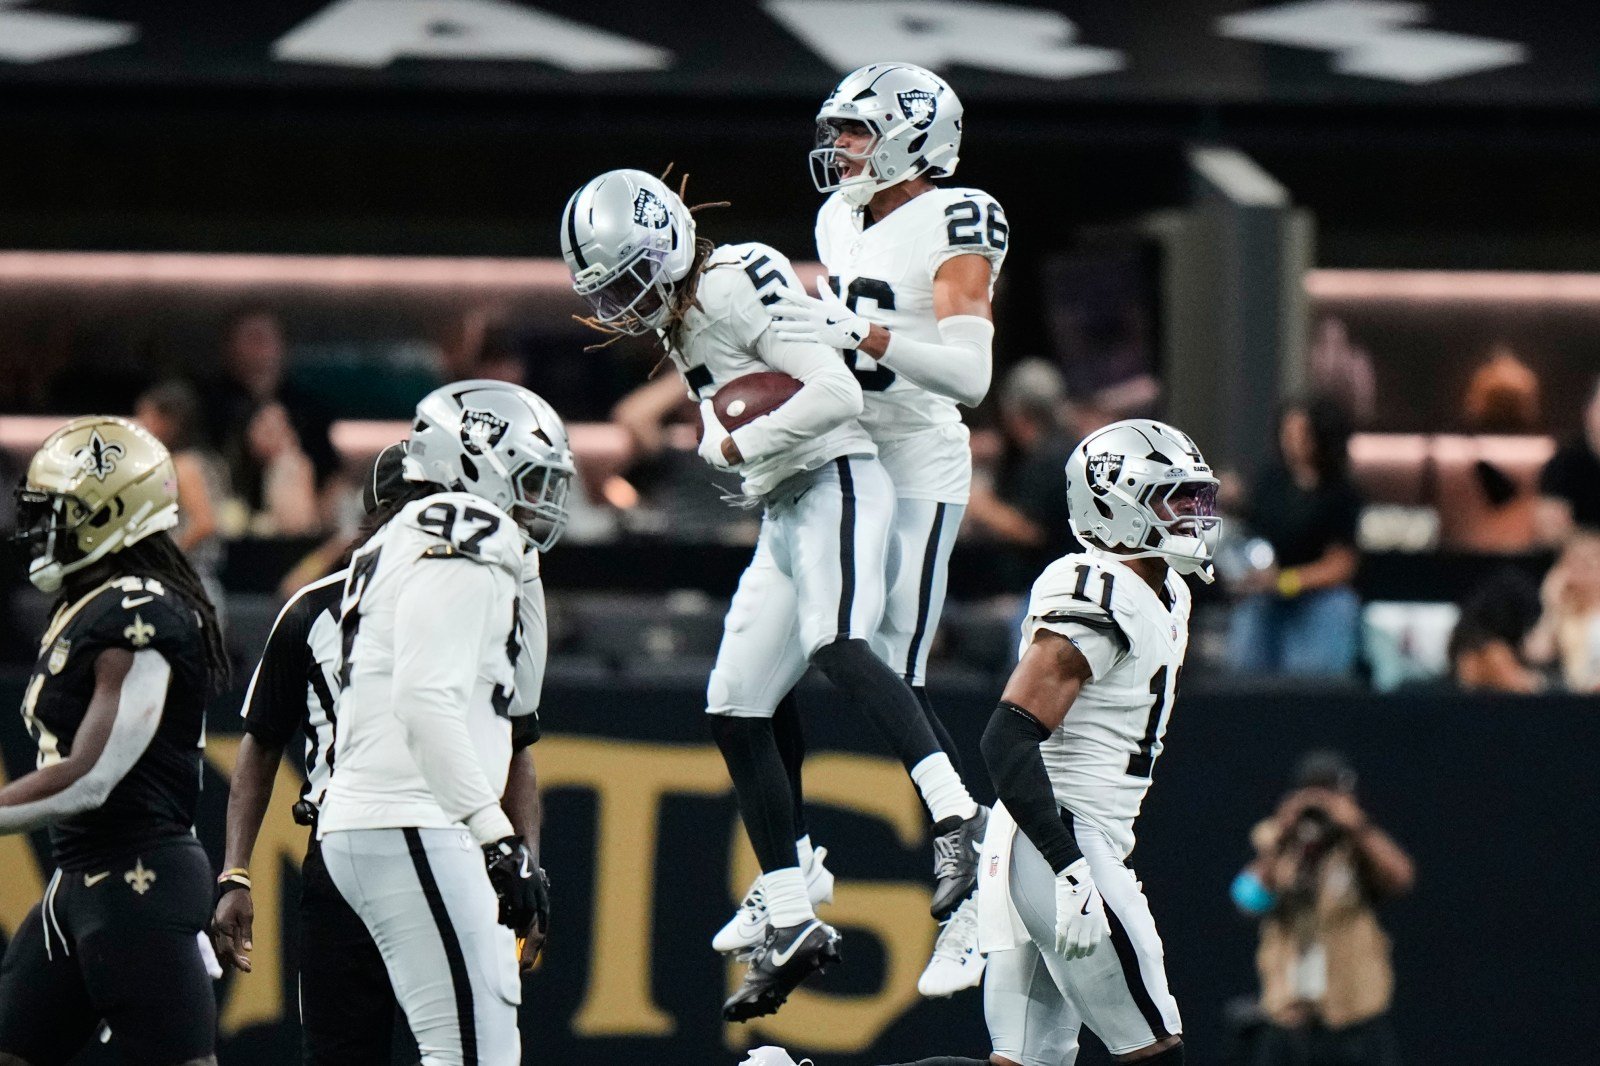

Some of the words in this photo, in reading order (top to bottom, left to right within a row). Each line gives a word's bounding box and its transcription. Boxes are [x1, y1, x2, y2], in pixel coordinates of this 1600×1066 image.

[945, 201, 1008, 251] 26
[828, 275, 897, 392] 6
[417, 502, 500, 555] 97
[1072, 564, 1115, 618] 11
